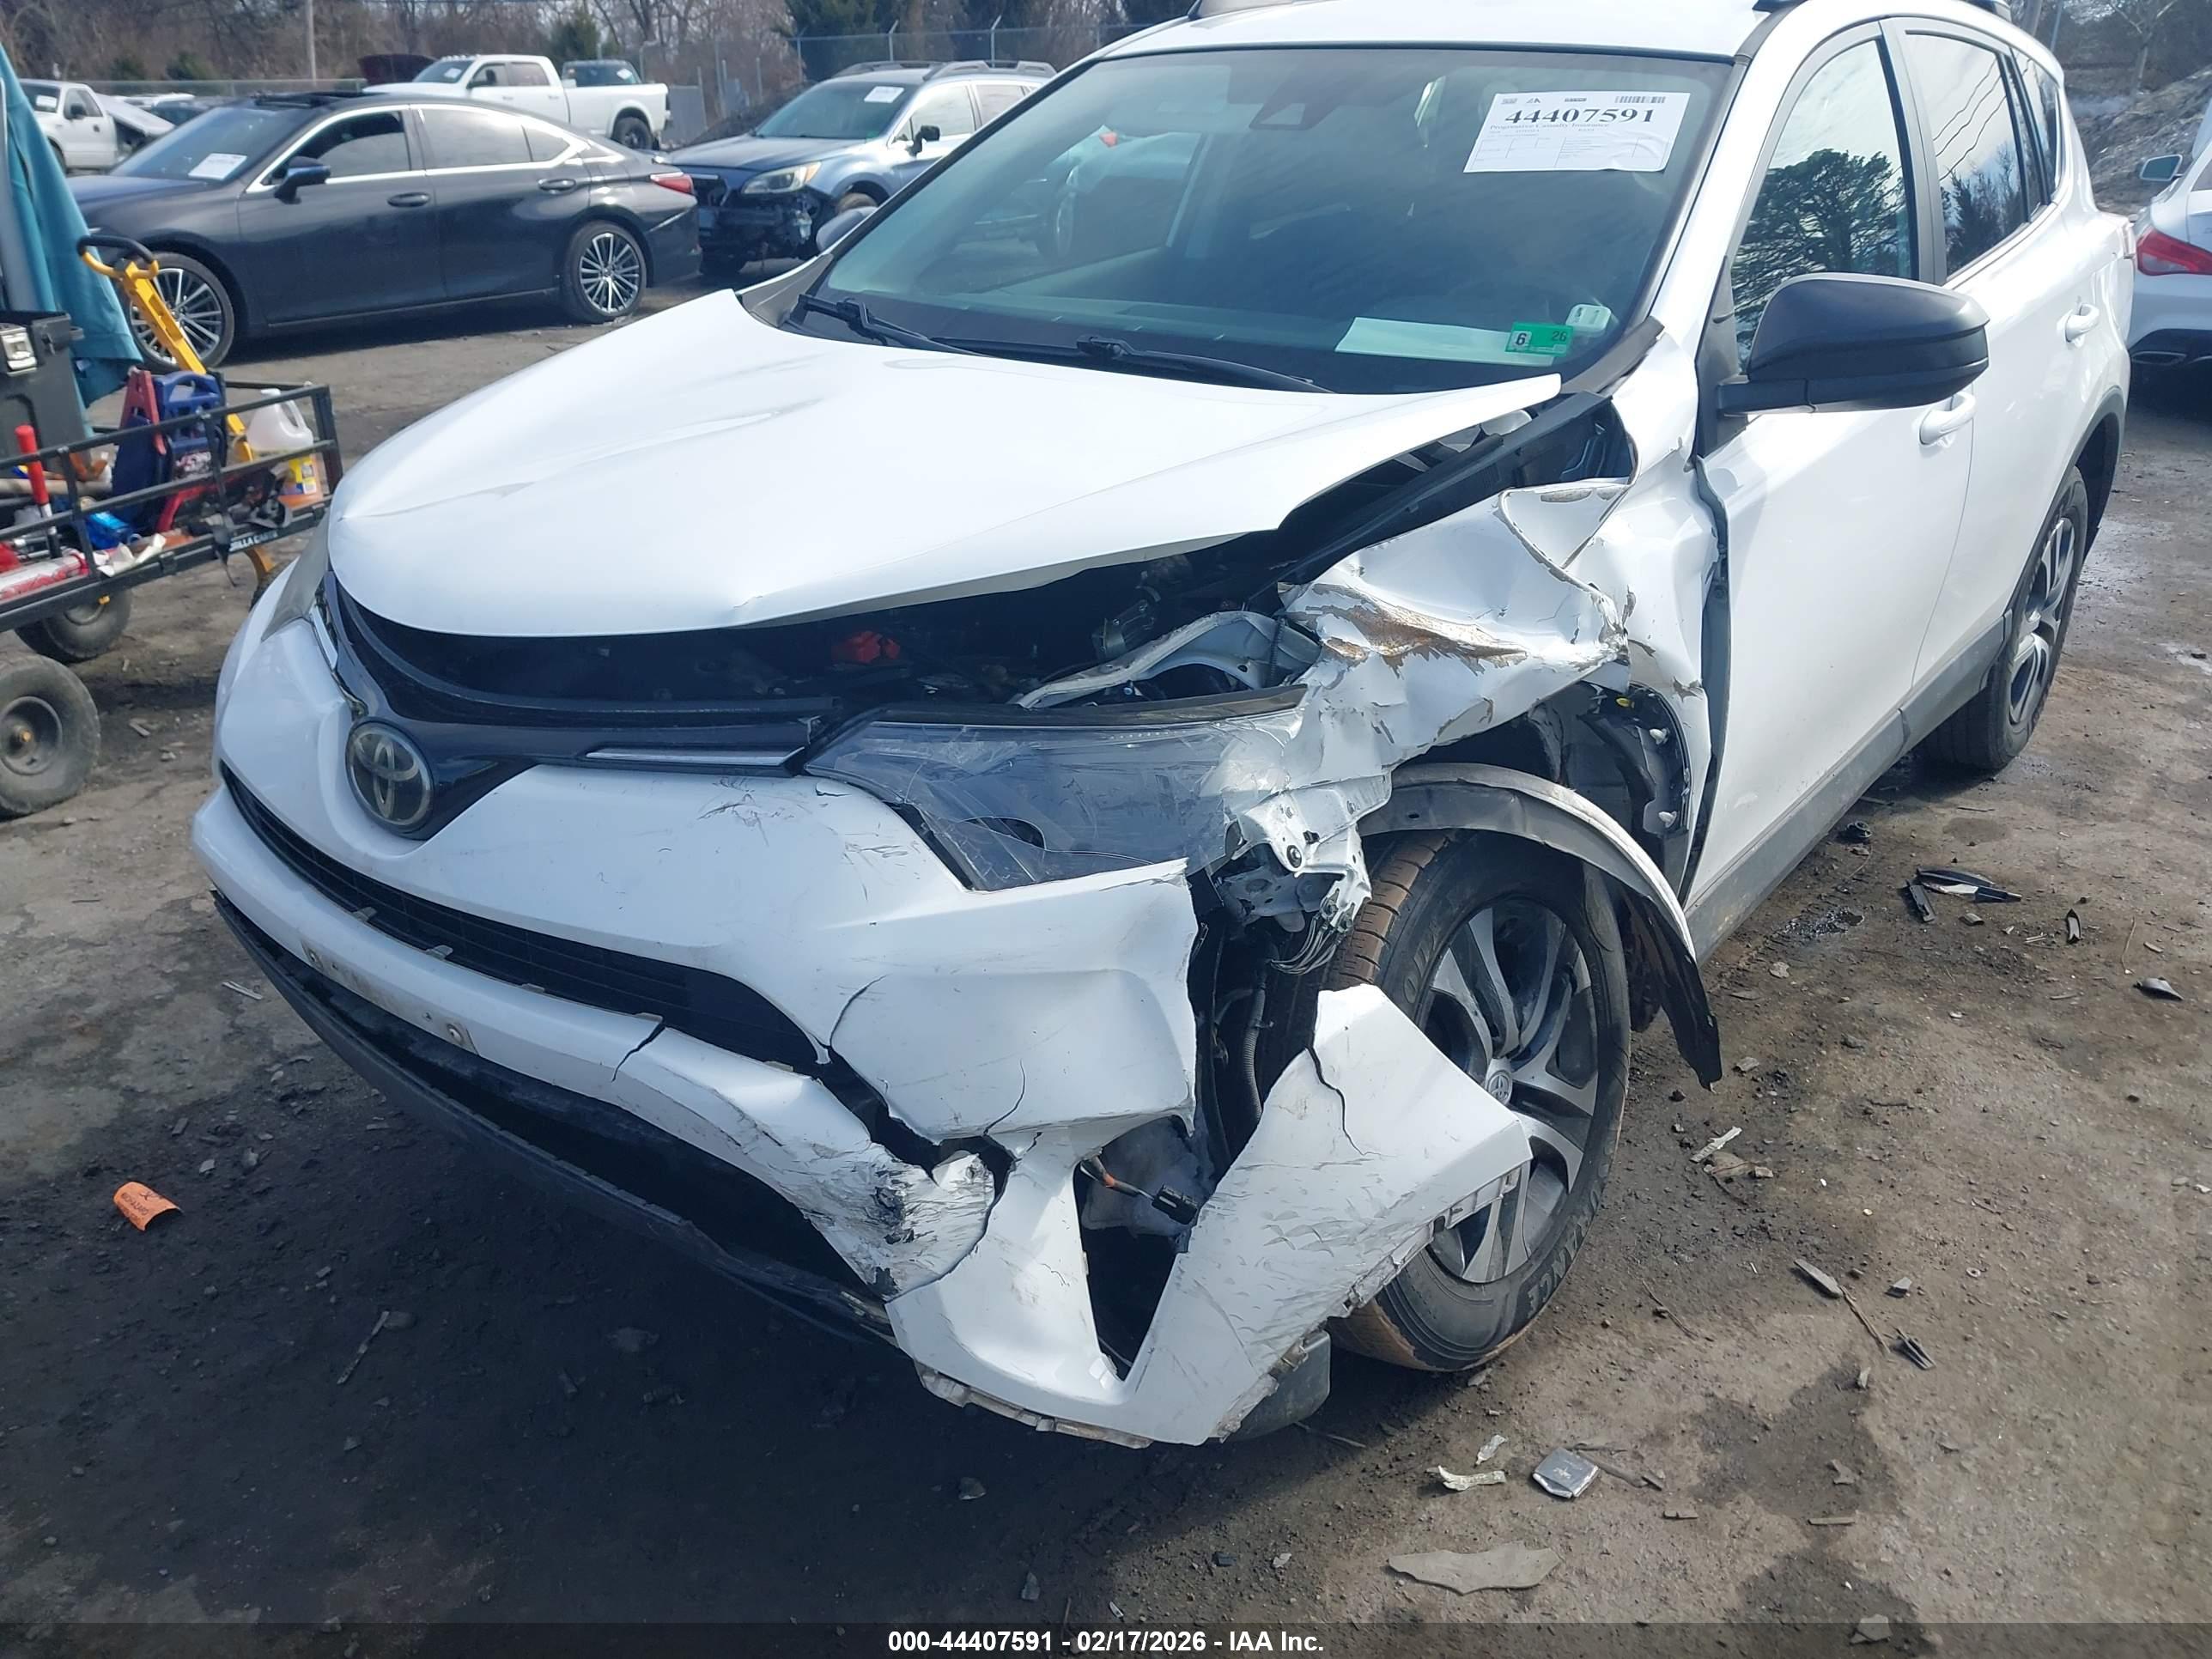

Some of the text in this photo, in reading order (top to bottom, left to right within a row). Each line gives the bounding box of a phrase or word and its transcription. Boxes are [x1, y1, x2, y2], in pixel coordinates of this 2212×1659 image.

[1505, 108, 1655, 124] 44407591
[1516, 330, 1567, 345] 6 26
